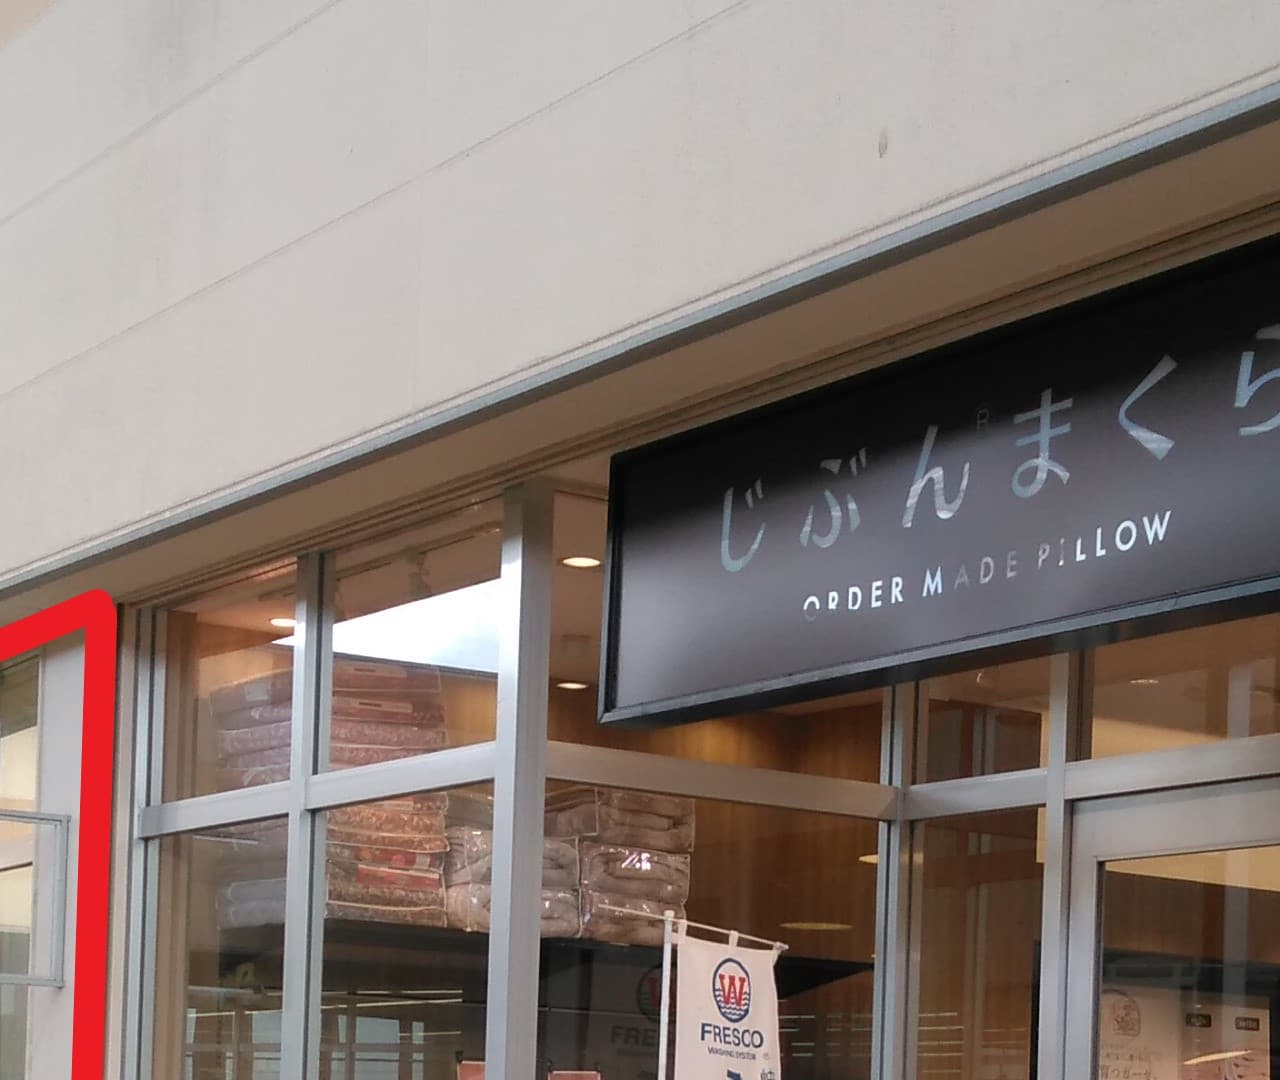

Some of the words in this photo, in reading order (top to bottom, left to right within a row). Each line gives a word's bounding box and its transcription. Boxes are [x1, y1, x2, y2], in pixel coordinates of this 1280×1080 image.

[802, 573, 906, 623] ORDER
[922, 546, 1020, 598] MADE
[1036, 508, 1174, 569] PILLOW
[700, 1022, 764, 1049] FRESCO
